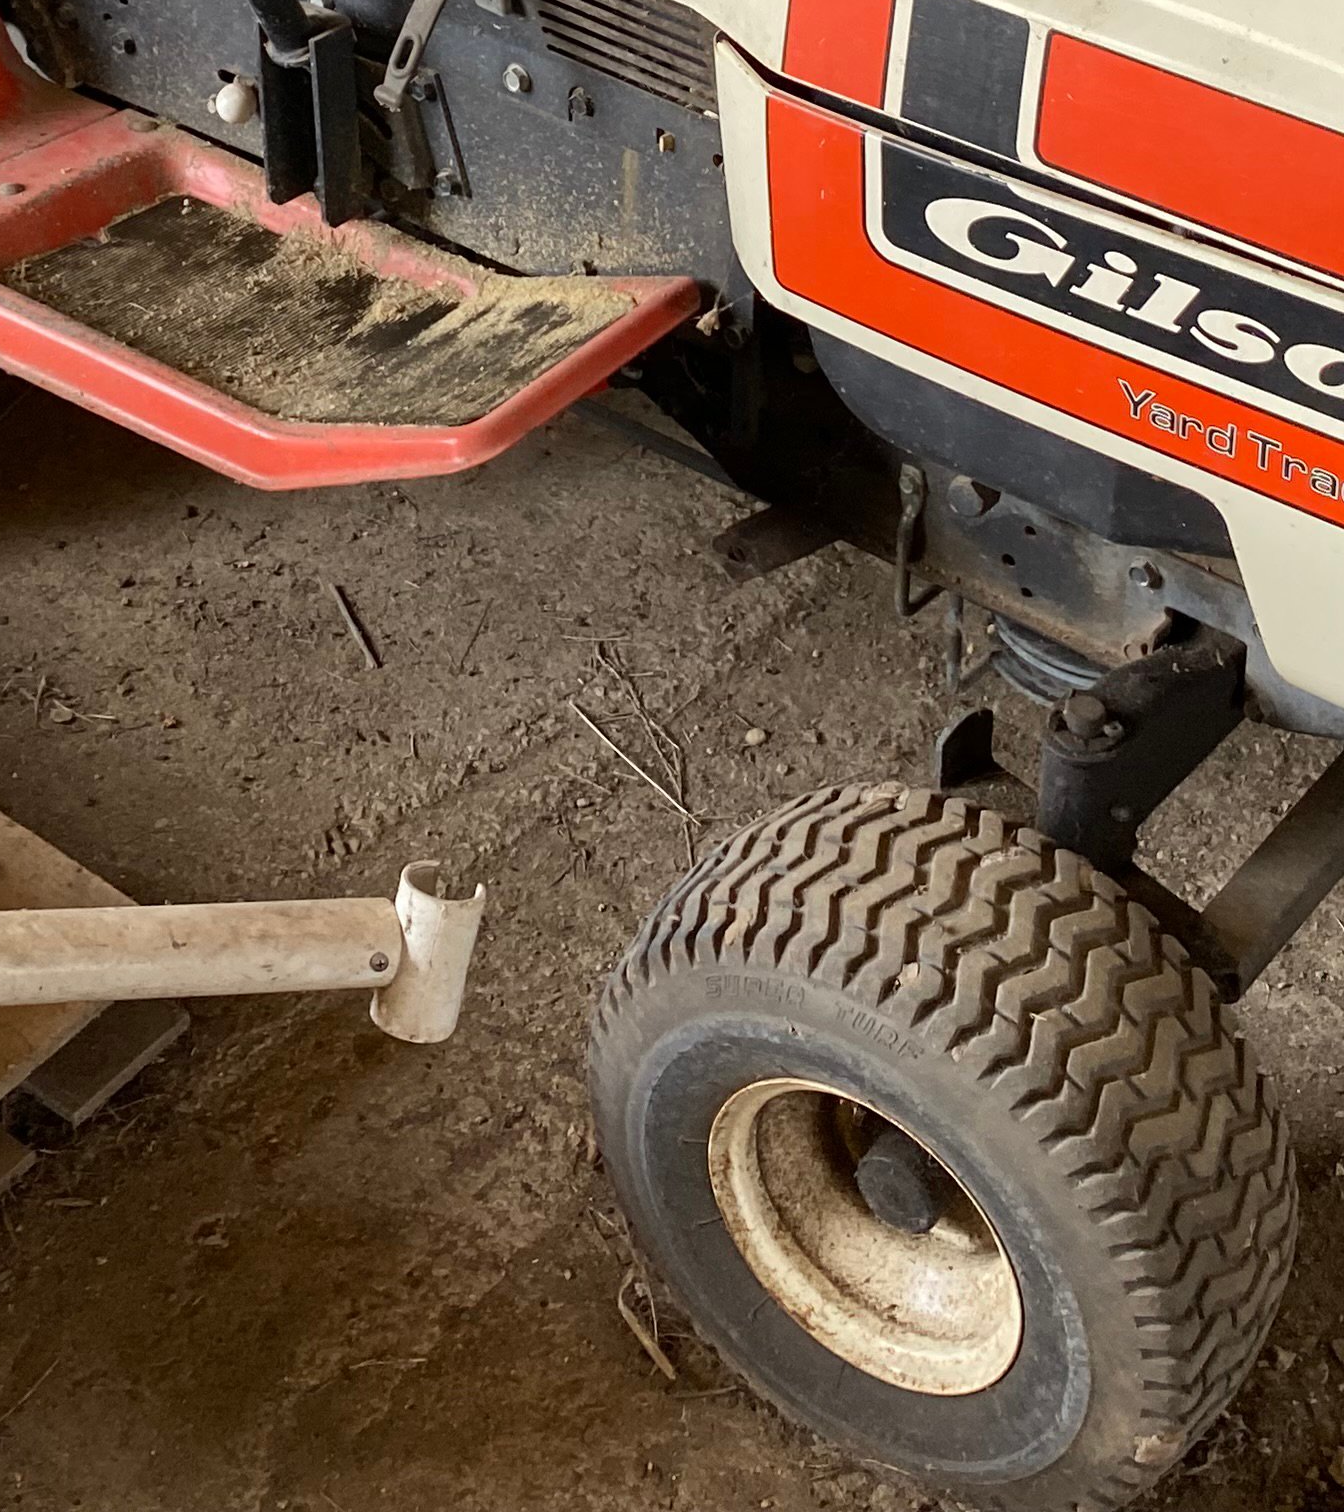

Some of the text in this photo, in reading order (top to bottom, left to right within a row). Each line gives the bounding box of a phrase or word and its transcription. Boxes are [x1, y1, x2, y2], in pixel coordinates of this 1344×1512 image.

[1115, 377, 1238, 460] Yard
[704, 975, 926, 1060] SUPER TURF
